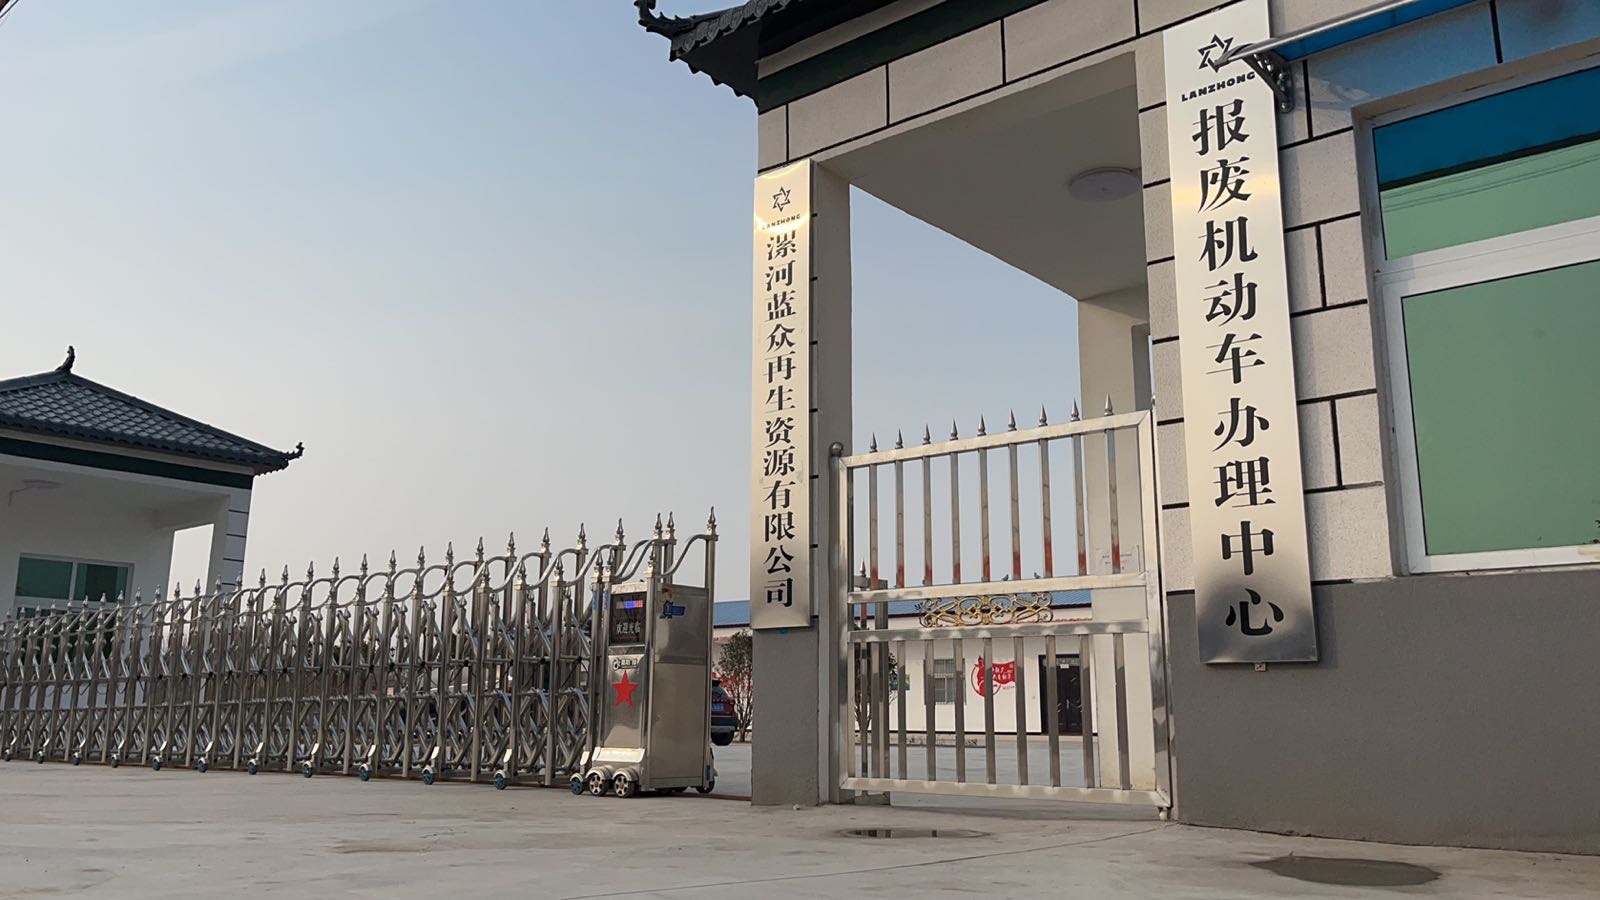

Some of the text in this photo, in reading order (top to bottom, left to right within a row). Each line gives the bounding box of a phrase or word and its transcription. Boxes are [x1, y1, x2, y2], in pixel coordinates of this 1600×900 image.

[1181, 71, 1256, 102] LANZHONG
[763, 229, 797, 608] 漯河蓝众再生资源有限公司
[1191, 98, 1284, 636] 报废机动车办理中心
